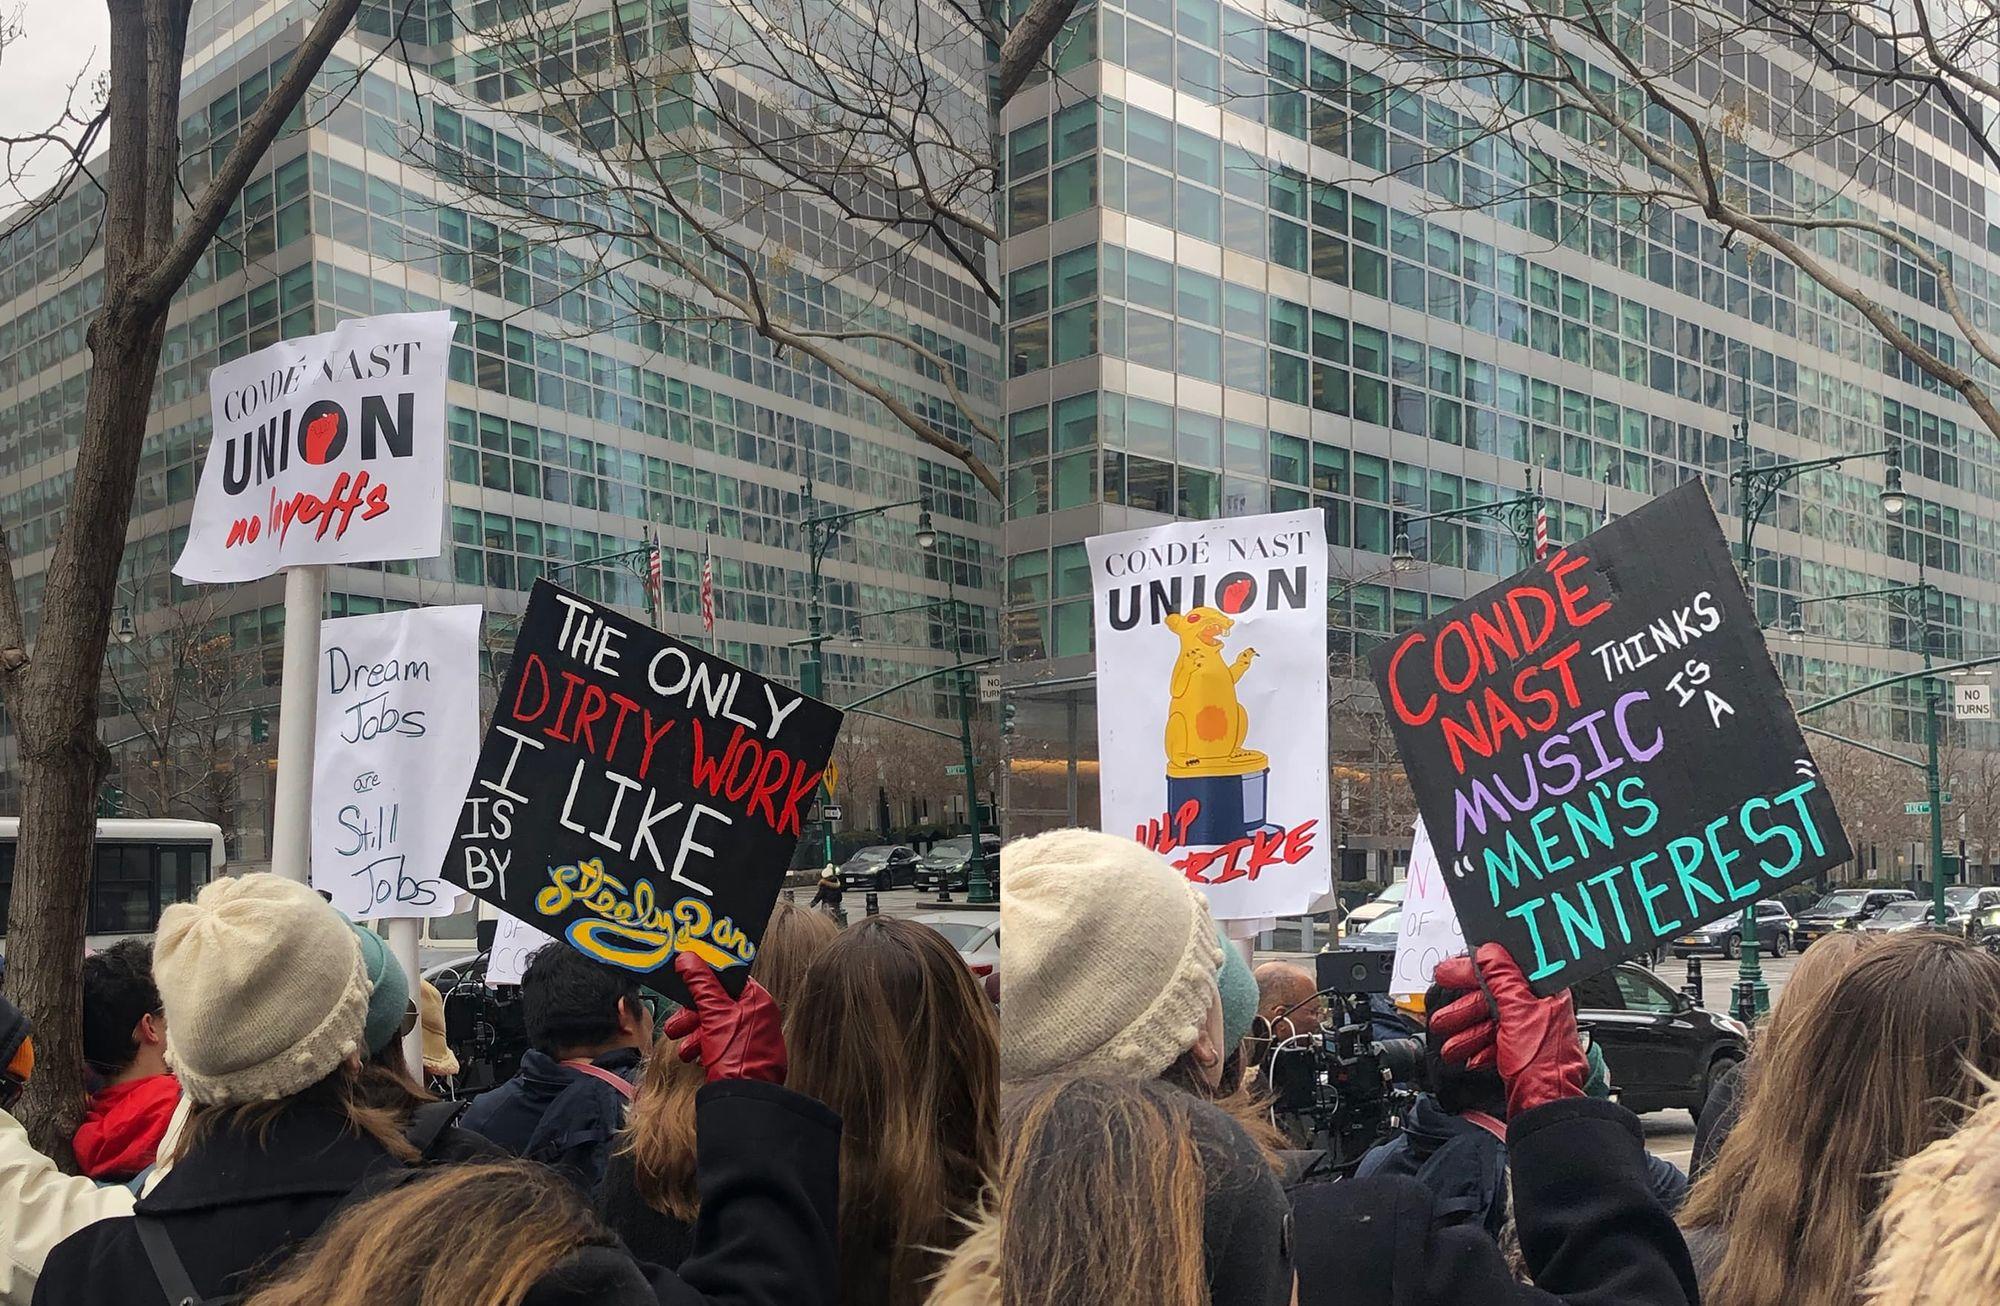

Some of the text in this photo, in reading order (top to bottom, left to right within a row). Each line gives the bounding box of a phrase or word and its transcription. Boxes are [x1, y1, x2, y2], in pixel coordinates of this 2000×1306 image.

[313, 341, 421, 385] NAST
[223, 393, 415, 495] UNION
[226, 470, 390, 552] no layoffs
[1105, 531, 1311, 577] CONDÉ NAST
[1108, 565, 1308, 632] UNION
[1388, 548, 1612, 727] CONDÉ
[325, 647, 430, 694] Dream
[555, 594, 803, 740] THE ONLY
[987, 679, 999, 687] NO
[1440, 591, 1721, 775] NAST THINKS
[1665, 658, 1711, 708] IS
[340, 691, 426, 744] Jobs
[982, 690, 1000, 698] TURN
[1704, 689, 1735, 729] A
[1956, 704, 1990, 715] TURNS
[1964, 690, 1981, 700] NO
[512, 654, 823, 836] DIRTY WORK
[1454, 689, 1664, 852] MUSIC
[354, 771, 381, 793] are
[335, 804, 399, 856] Still
[460, 796, 514, 841] IS
[480, 725, 733, 897] I LIKE
[465, 847, 512, 900] BY
[1171, 819, 1319, 885] RIKE
[351, 854, 441, 914] Jobs
[535, 857, 756, 973] Steely Dan
[1406, 910, 1434, 937] OF
